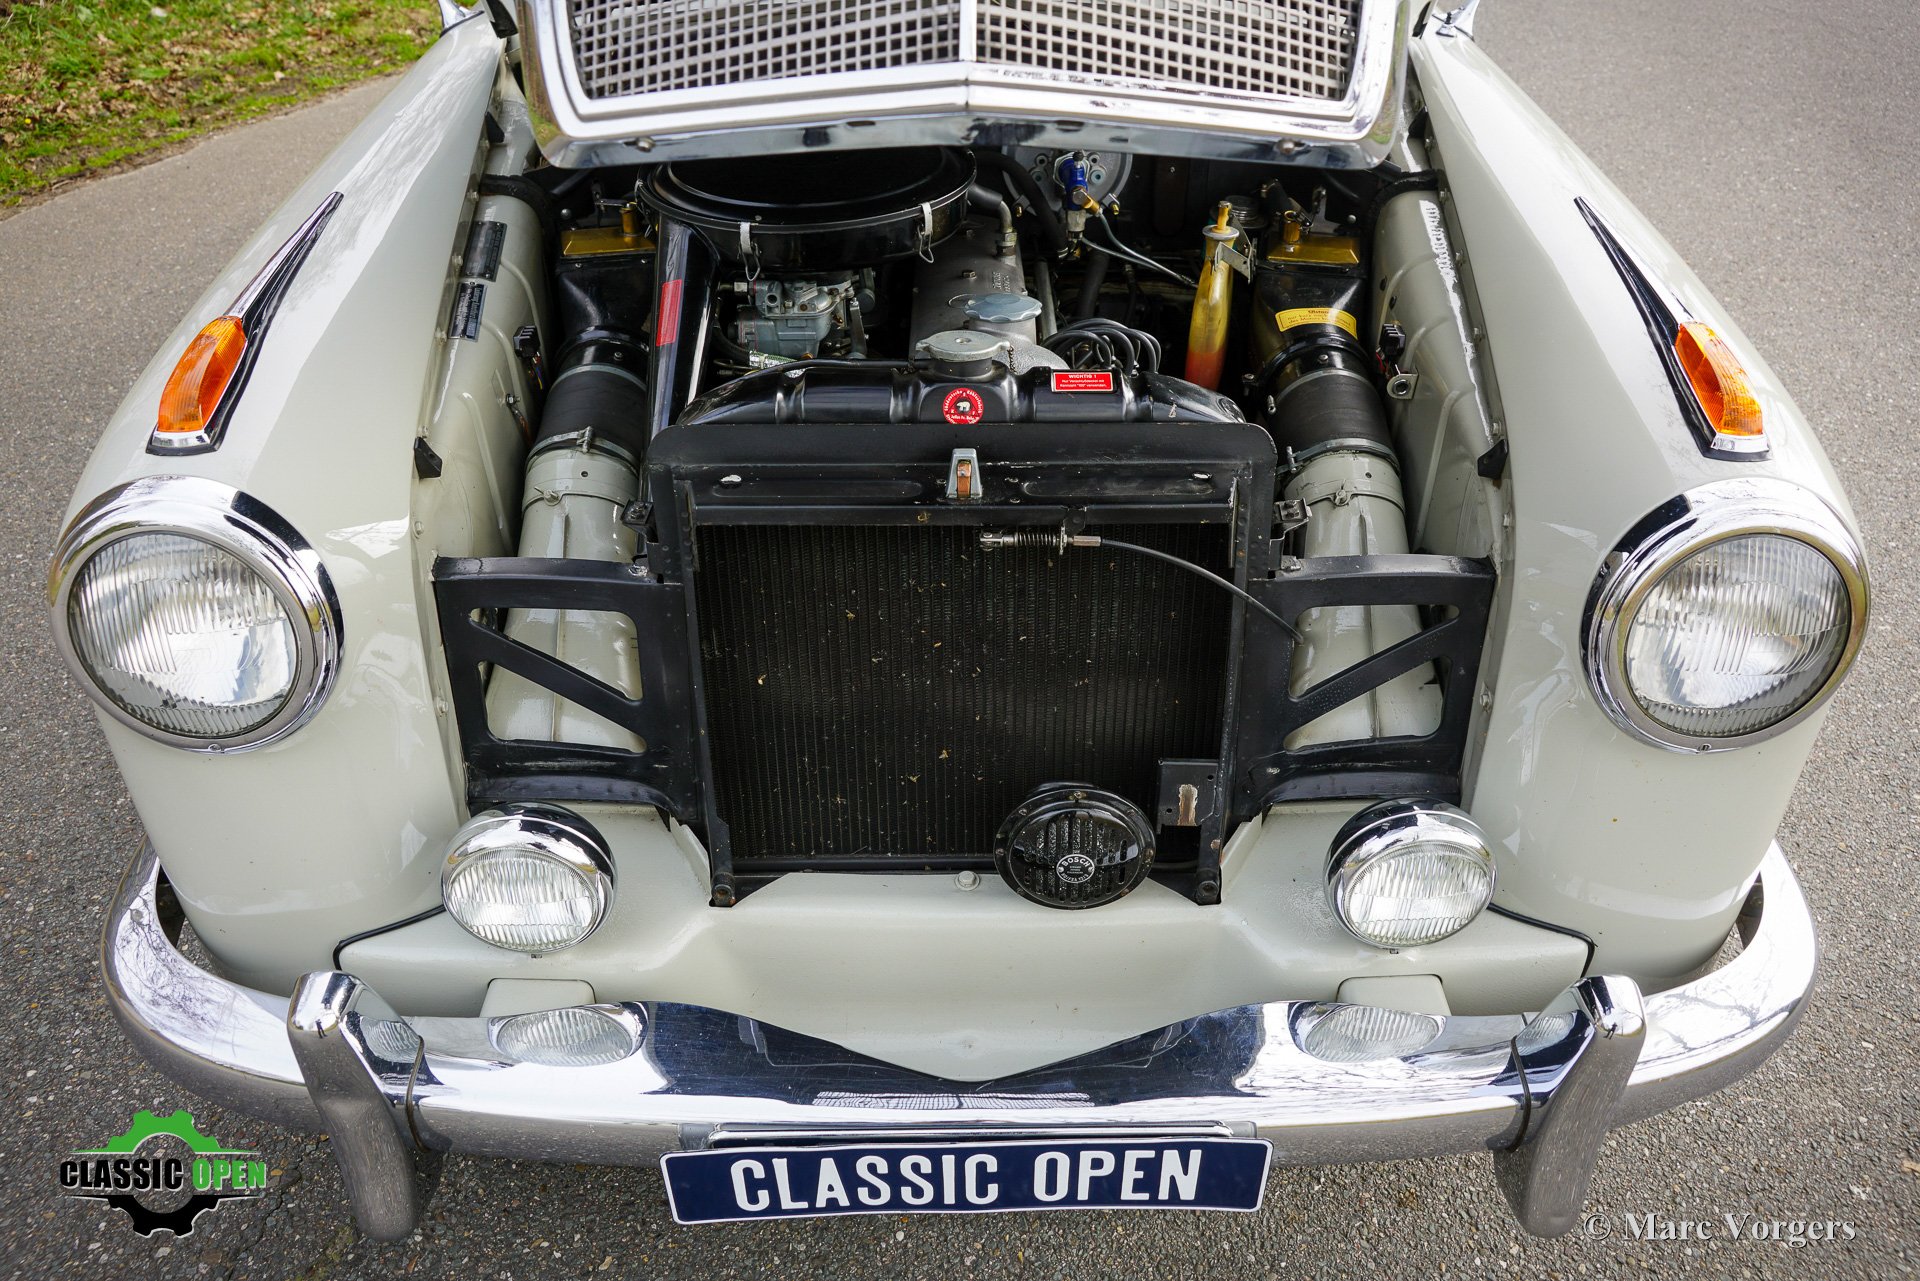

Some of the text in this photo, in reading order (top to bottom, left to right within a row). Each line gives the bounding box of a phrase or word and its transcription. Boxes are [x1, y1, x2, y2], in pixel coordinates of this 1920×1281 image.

[1061, 856, 1091, 867] BOSCH
[730, 1149, 1202, 1212] CLASSIC OPEN
